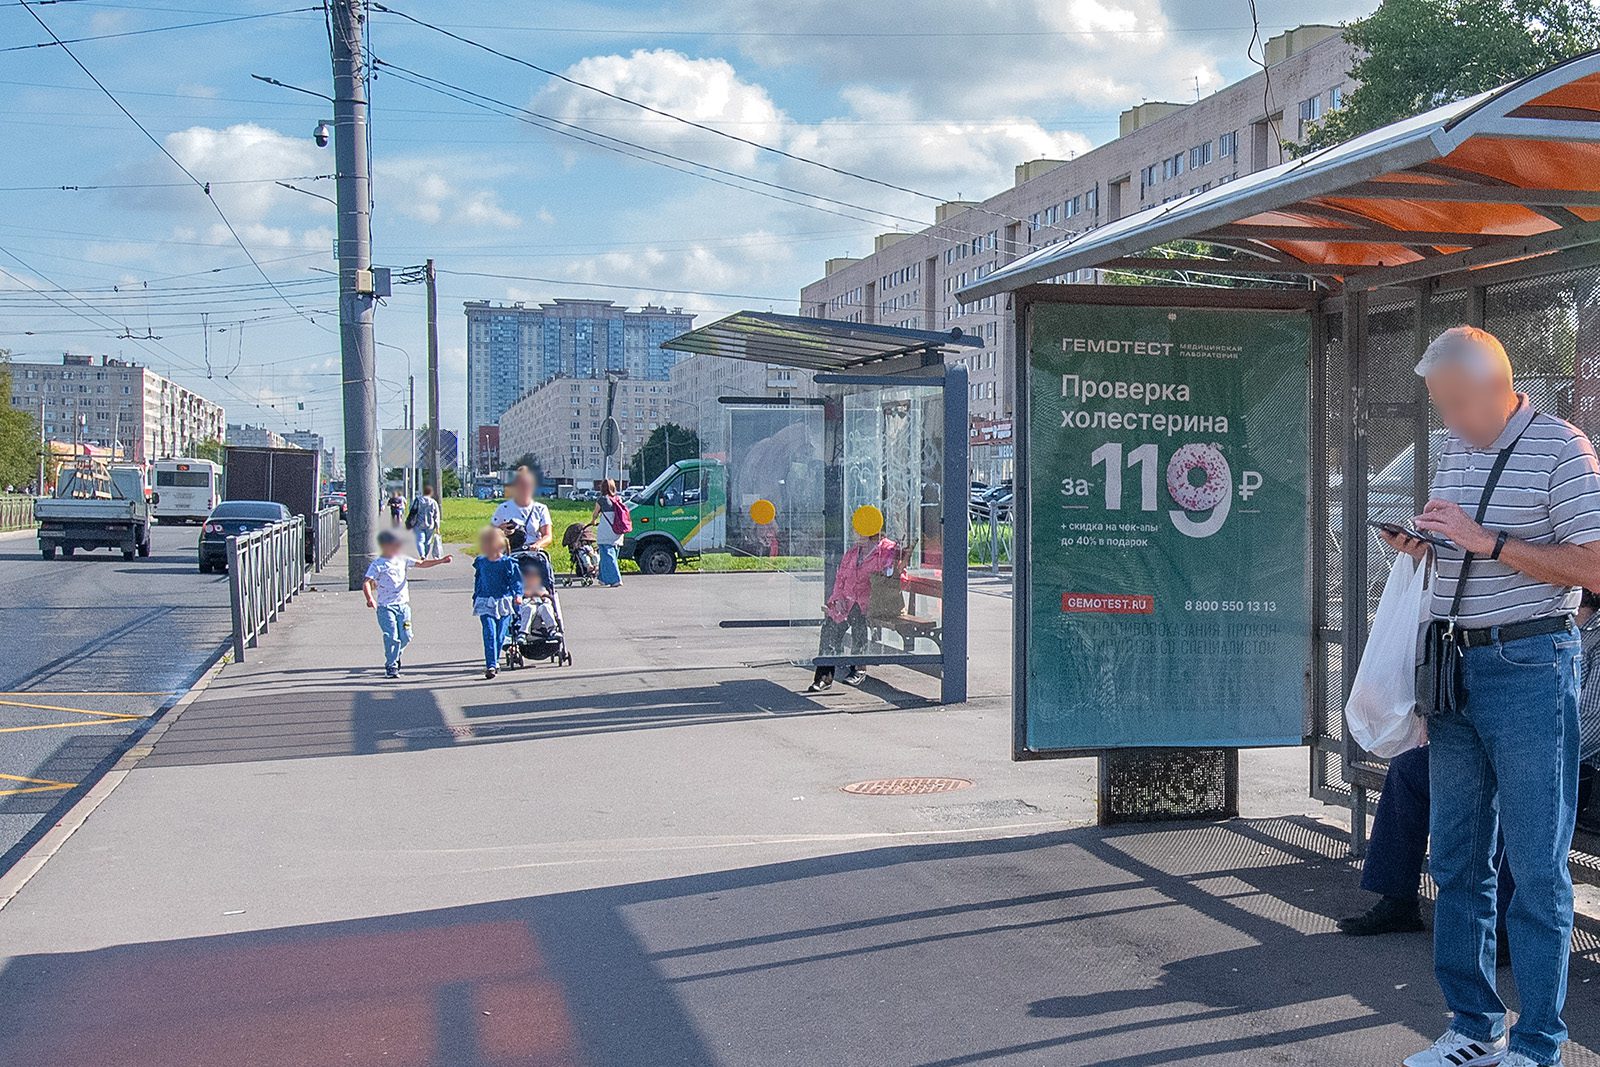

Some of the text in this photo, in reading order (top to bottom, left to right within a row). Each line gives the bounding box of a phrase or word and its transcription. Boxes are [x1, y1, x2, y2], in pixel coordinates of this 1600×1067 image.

[1062, 338, 1174, 356] ГЕМОТЕСТ
[1180, 343, 1243, 352] МЕДИЦИНСКАЯ
[1179, 351, 1239, 359] ЛАБОРАТОРИЯ
[1061, 374, 1190, 405] Проверка
[1060, 409, 1229, 437] холестерина
[1061, 477, 1090, 496] за
[1091, 442, 1233, 538] 119
[1069, 522, 1104, 532] скидка
[1105, 524, 1118, 532] на
[1118, 524, 1159, 533] чек-апы
[1060, 536, 1148, 548] до 40% в подарок
[1067, 597, 1147, 610] GEMOTEST.RU
[1184, 600, 1277, 612] 8 800 550 13 13
